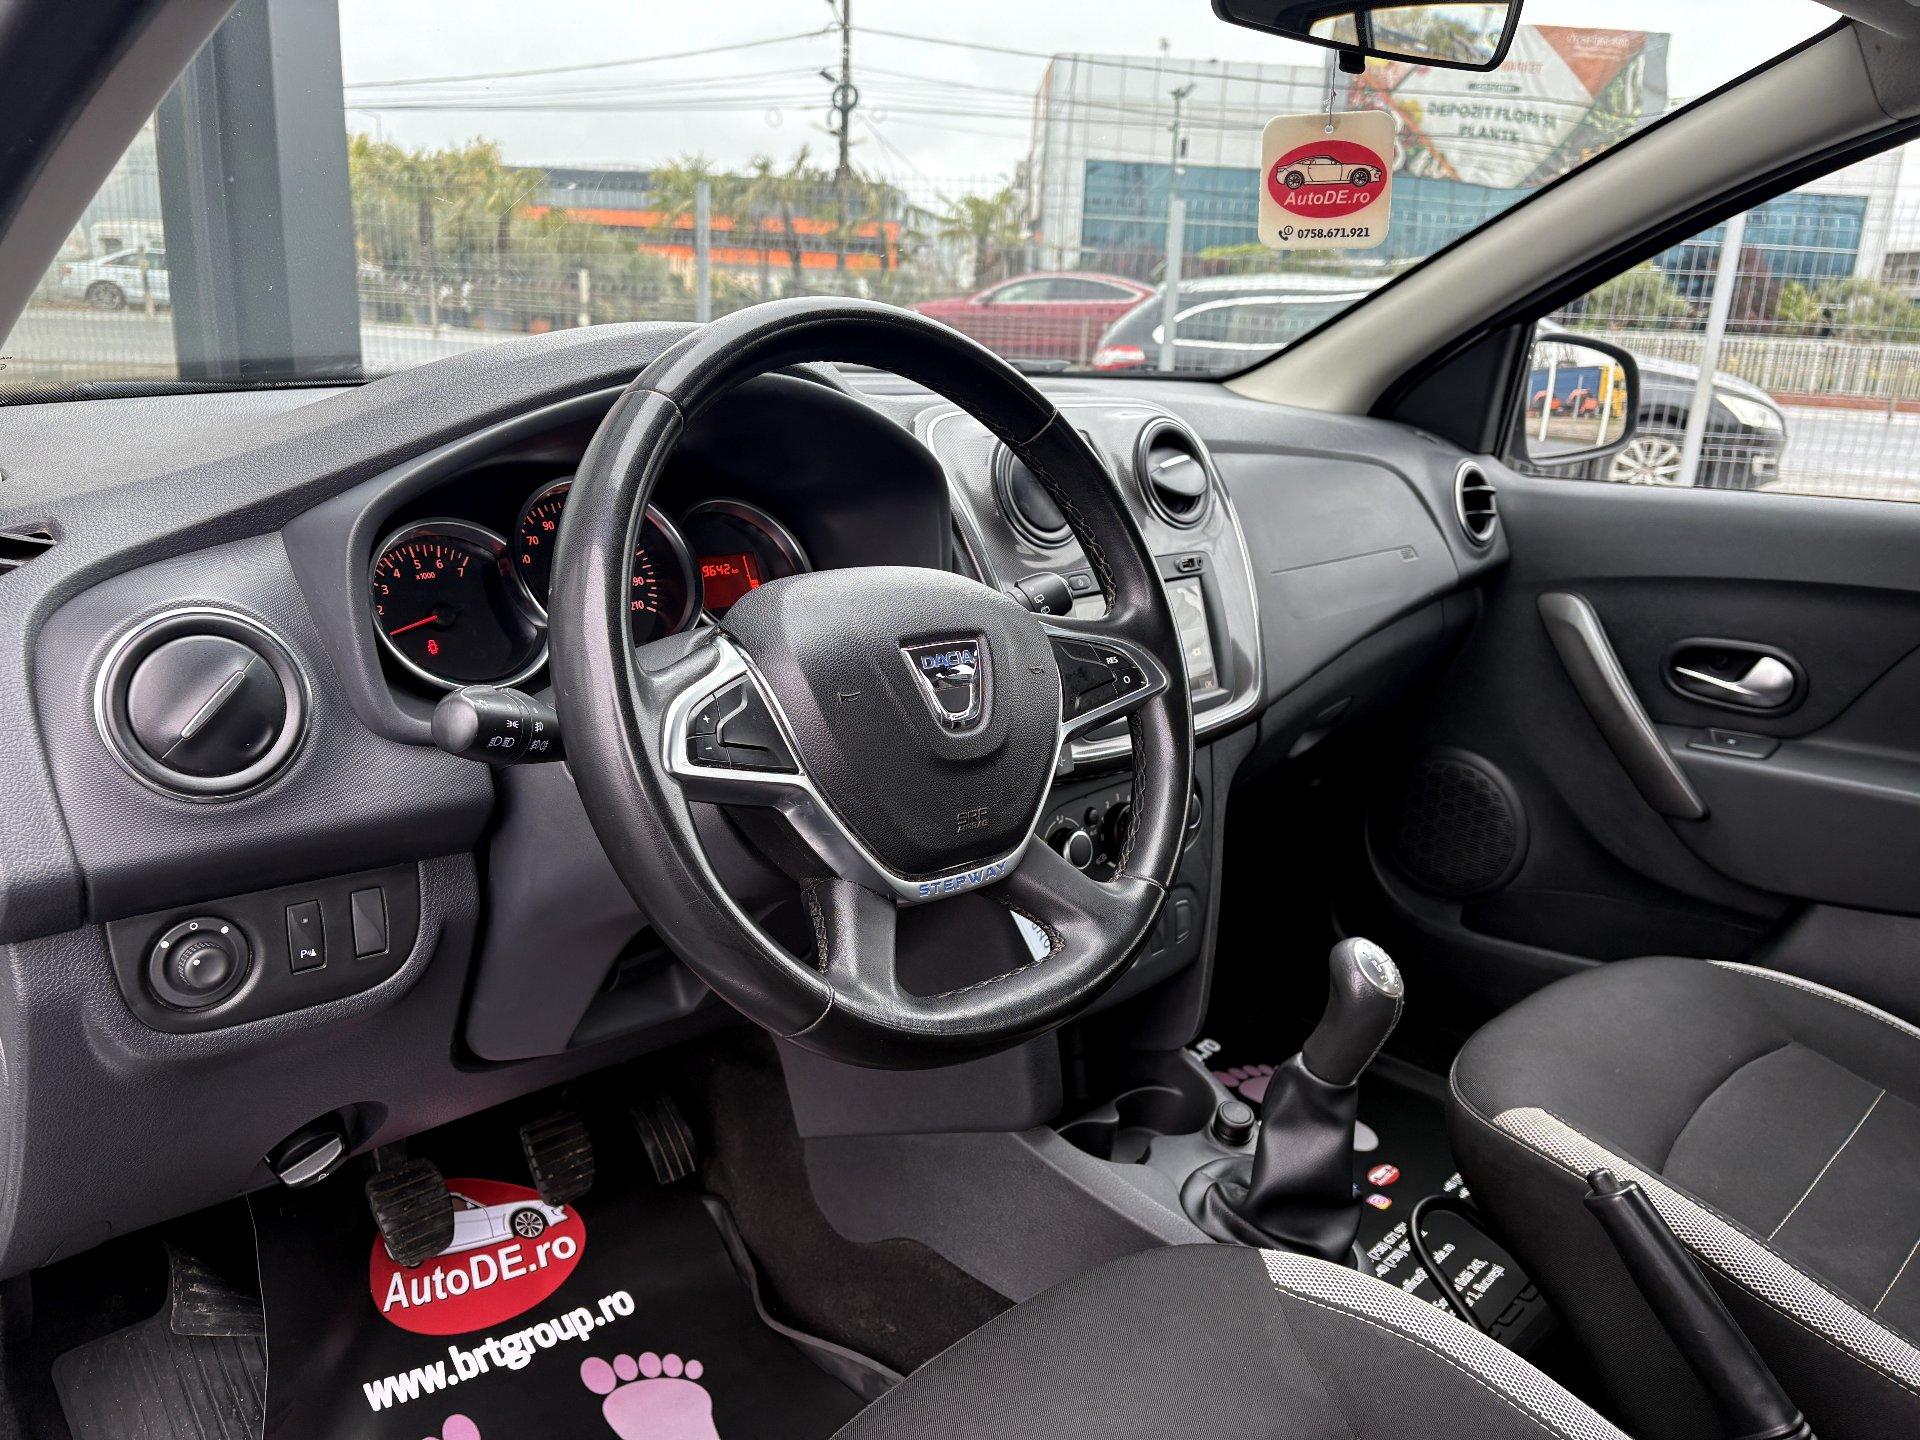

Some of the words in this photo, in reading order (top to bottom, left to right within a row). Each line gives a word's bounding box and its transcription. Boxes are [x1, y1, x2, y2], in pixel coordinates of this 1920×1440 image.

[1284, 189, 1370, 206] AutoDE.ro
[1297, 227, 1370, 239] 0758.671.921
[542, 520, 555, 531] 90
[526, 535, 539, 546] 70
[414, 559, 421, 570] 5
[436, 559, 444, 569] 6
[393, 568, 401, 578] 4
[416, 571, 436, 580] x1000
[457, 567, 464, 578] 7
[381, 584, 389, 595] 3
[376, 605, 385, 615] 2
[920, 650, 975, 669] DACIA
[1106, 656, 1119, 665] RES
[919, 861, 1007, 898] STEPWAY
[382, 1236, 577, 1313] AutoDE.ro
[363, 1291, 635, 1412] www.brtgroup.ro
